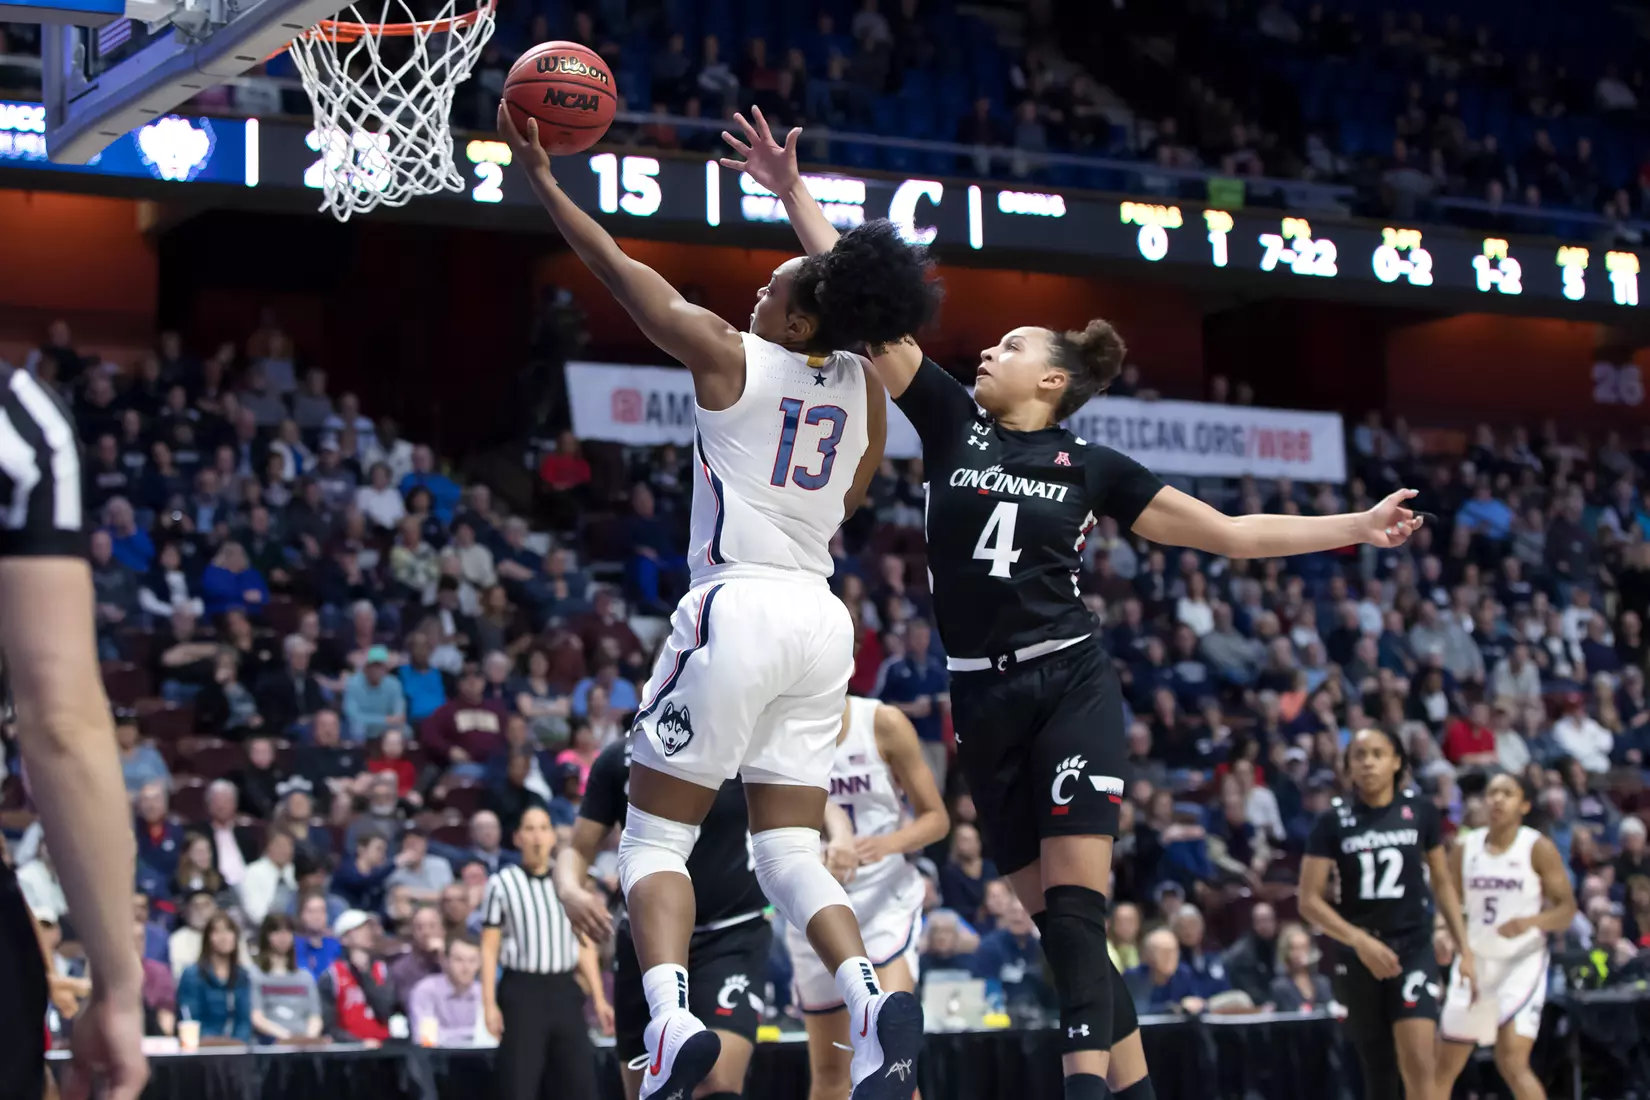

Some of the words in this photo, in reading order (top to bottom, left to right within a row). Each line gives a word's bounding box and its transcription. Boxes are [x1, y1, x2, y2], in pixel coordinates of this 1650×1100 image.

[536, 56, 609, 86] Wilson
[542, 87, 600, 112] NCAA
[472, 161, 504, 203] 2
[588, 152, 662, 217] 15
[1137, 223, 1169, 262] 0
[1207, 230, 1229, 267] 1
[1258, 233, 1338, 277] 7-22
[1372, 244, 1434, 286] 0-2
[1472, 254, 1523, 295] 1-2
[770, 397, 848, 491] 13
[949, 466, 1068, 502] CINCINNATI
[972, 501, 1023, 578] 4
[1358, 847, 1406, 900] 12
[1482, 896, 1498, 925] 5
